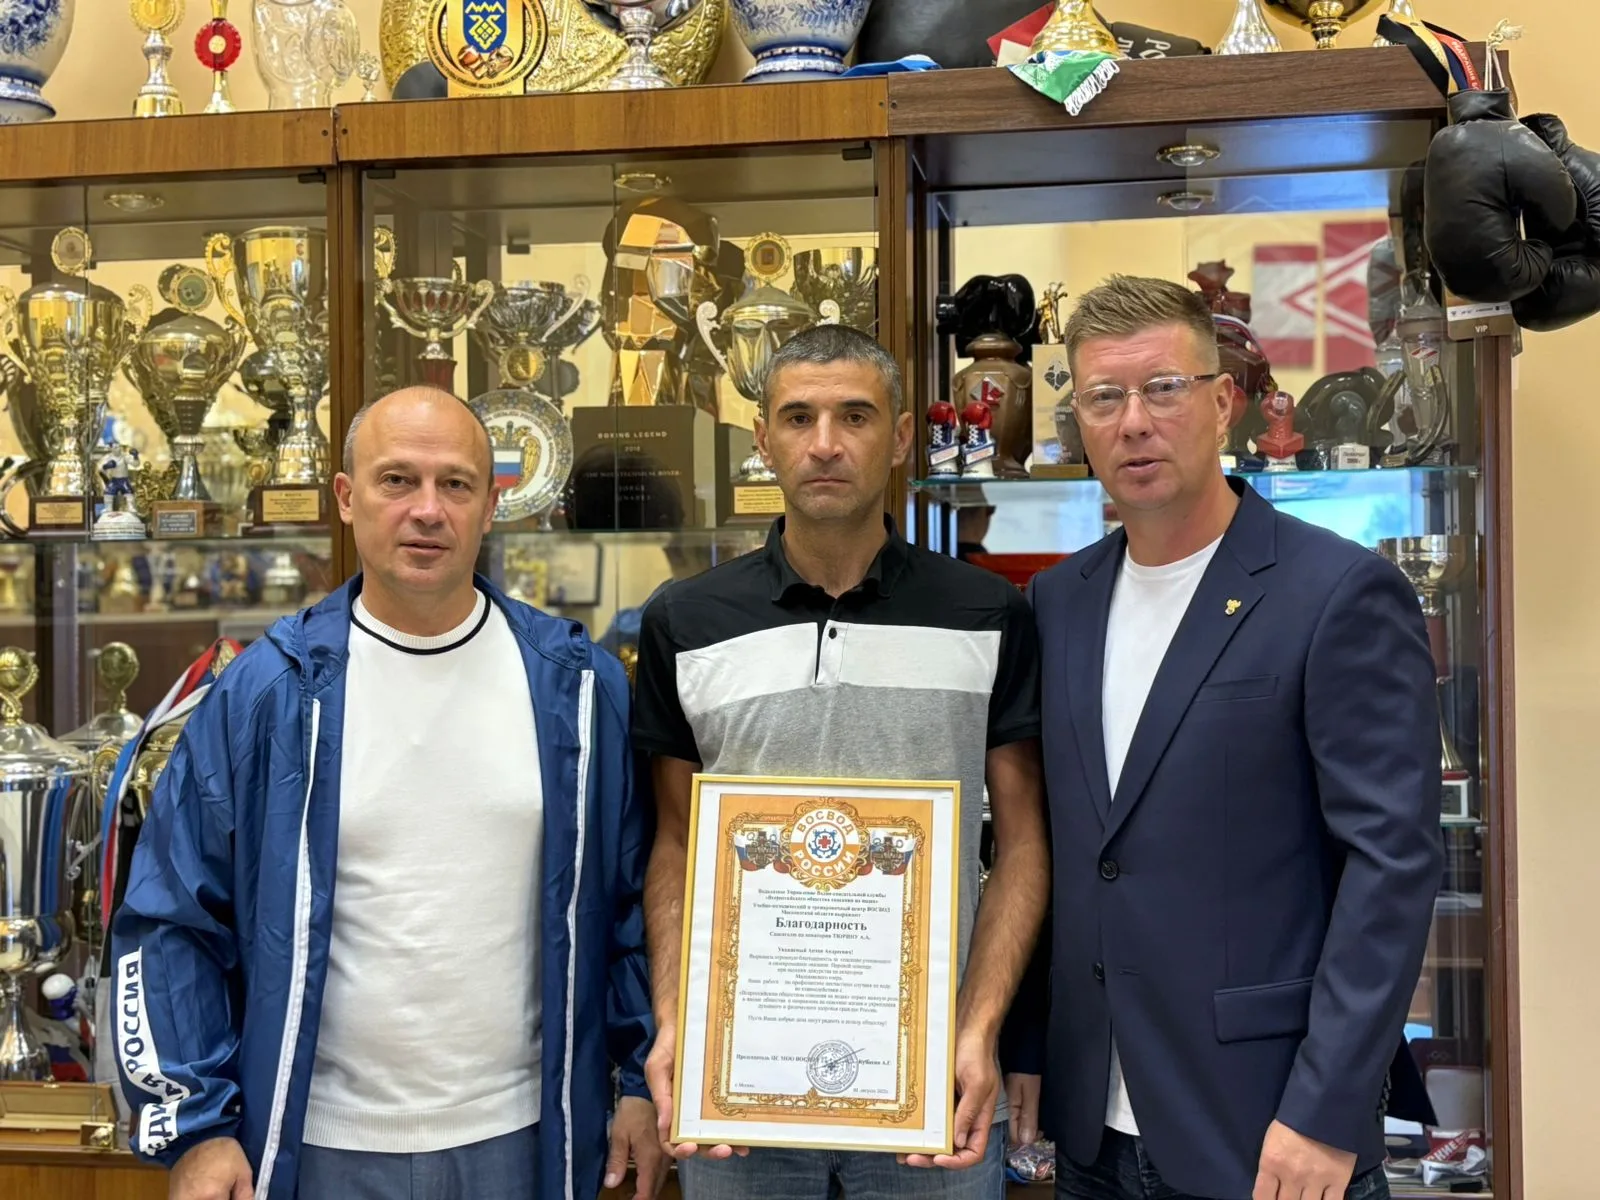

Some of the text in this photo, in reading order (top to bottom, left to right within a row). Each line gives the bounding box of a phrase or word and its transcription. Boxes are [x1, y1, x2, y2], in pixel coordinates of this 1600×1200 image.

[1475, 325, 1488, 333] VIP
[797, 810, 855, 834] ВОСВОД
[792, 851, 855, 876] РОССИИ
[776, 917, 868, 932] Благодарность
[124, 961, 147, 1074] РОССИЯ
